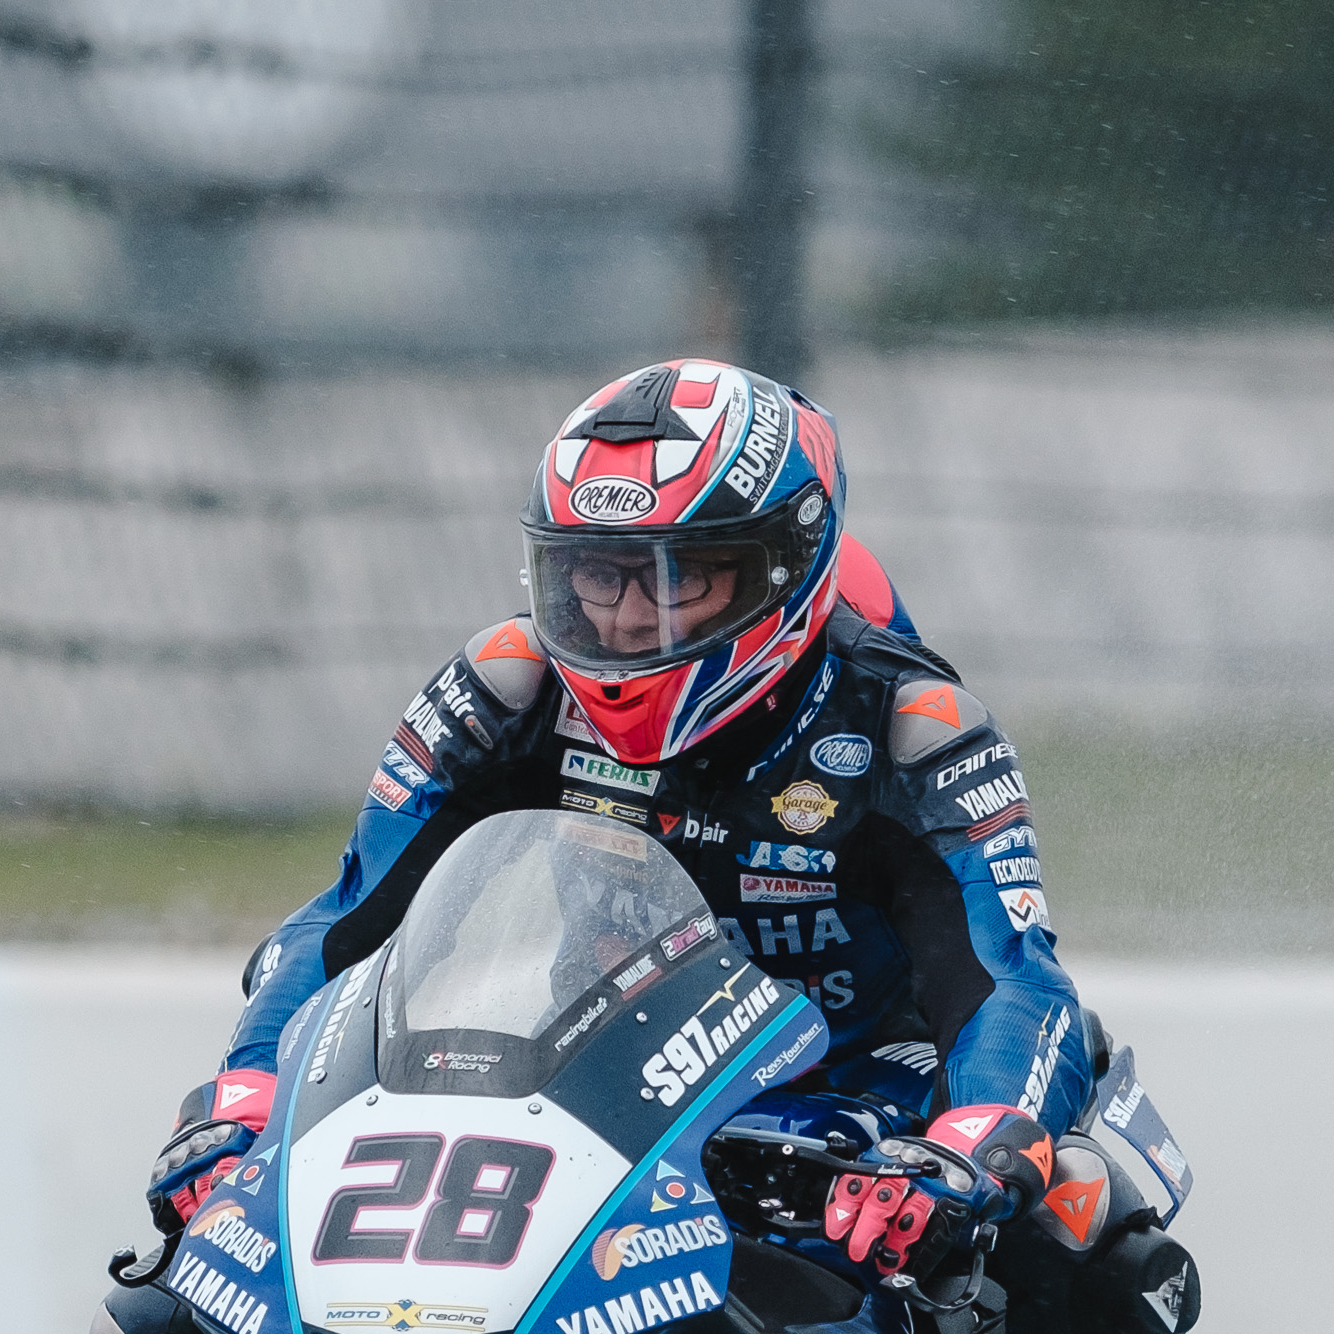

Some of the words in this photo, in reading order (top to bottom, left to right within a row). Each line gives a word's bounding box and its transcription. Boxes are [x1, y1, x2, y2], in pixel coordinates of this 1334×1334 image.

[725, 385, 781, 499] BURNELL
[577, 485, 654, 515] PREMIER
[936, 742, 1018, 791] DAINESE
[762, 878, 835, 894] YAMAHA
[641, 1014, 718, 1107] S97
[708, 975, 781, 1056] RACING
[310, 1131, 557, 1270] 28
[325, 1310, 381, 1320] MOTO
[425, 1312, 487, 1326] racing
